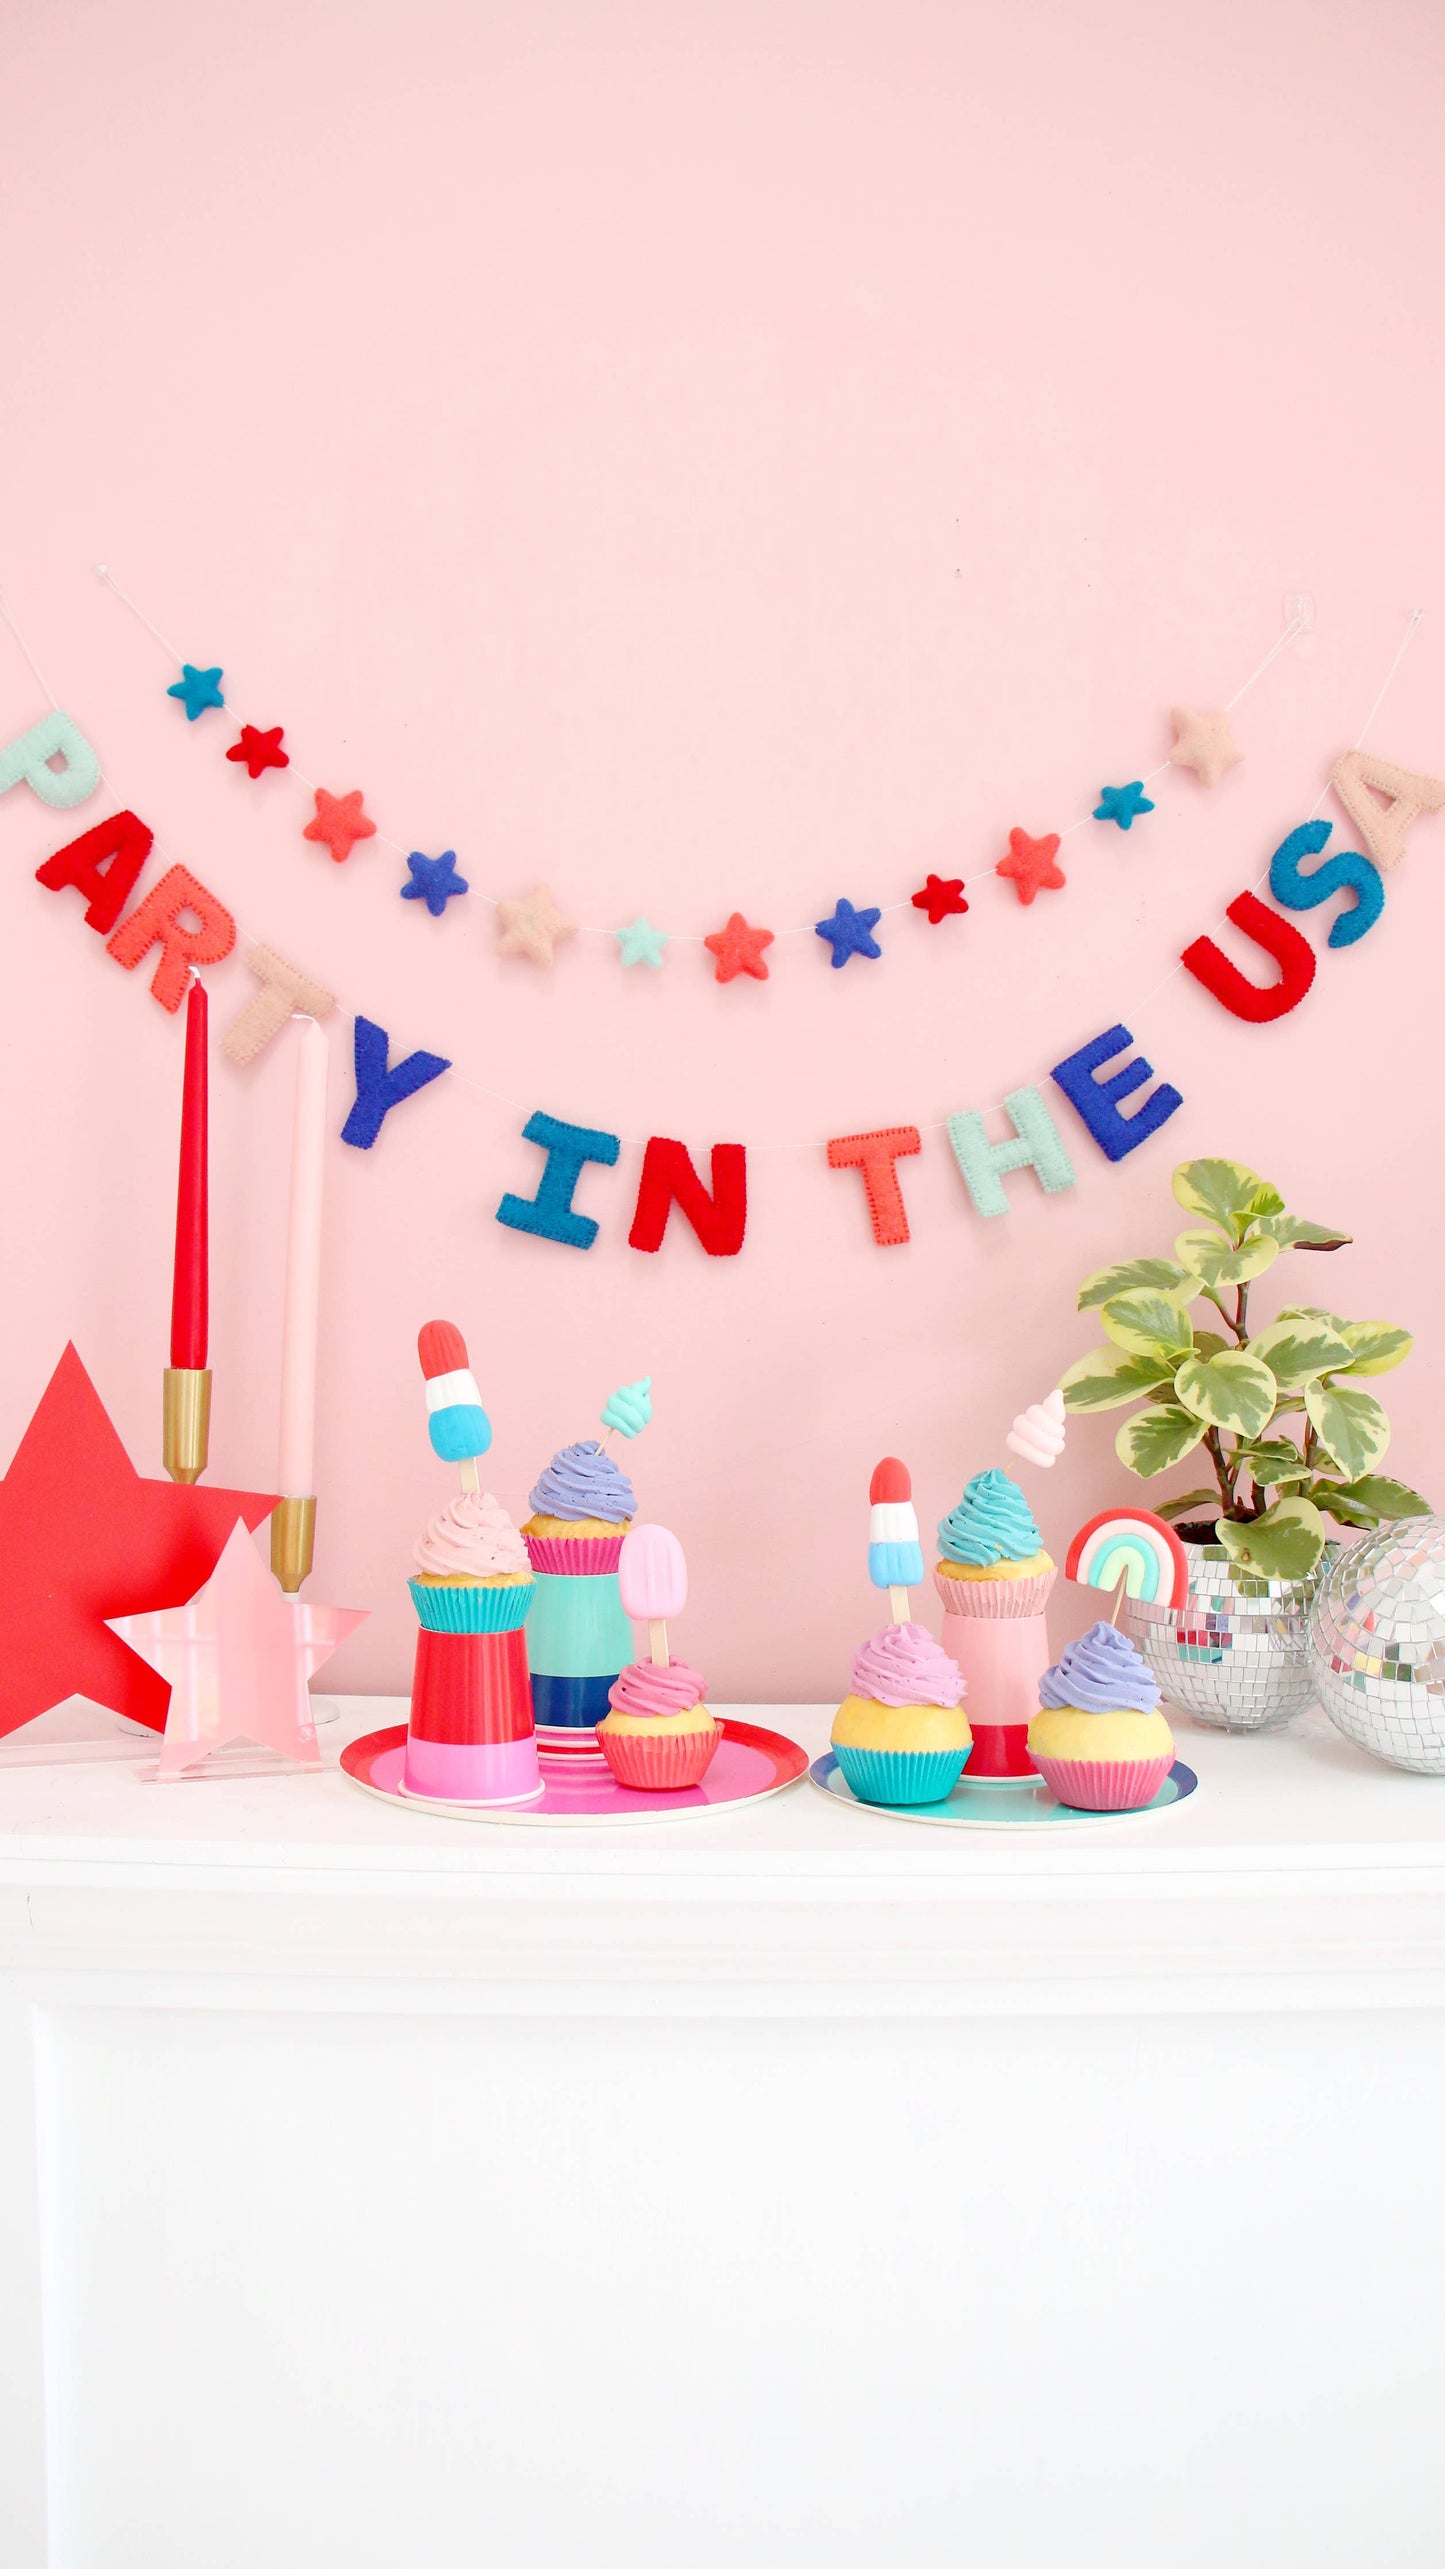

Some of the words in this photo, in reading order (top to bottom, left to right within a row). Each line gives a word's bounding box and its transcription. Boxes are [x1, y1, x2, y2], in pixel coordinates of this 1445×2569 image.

[0, 711, 452, 1149] PARTY
[496, 1111, 747, 1257] IN
[827, 1025, 1183, 1246] THE
[1182, 751, 1445, 1023] USA
